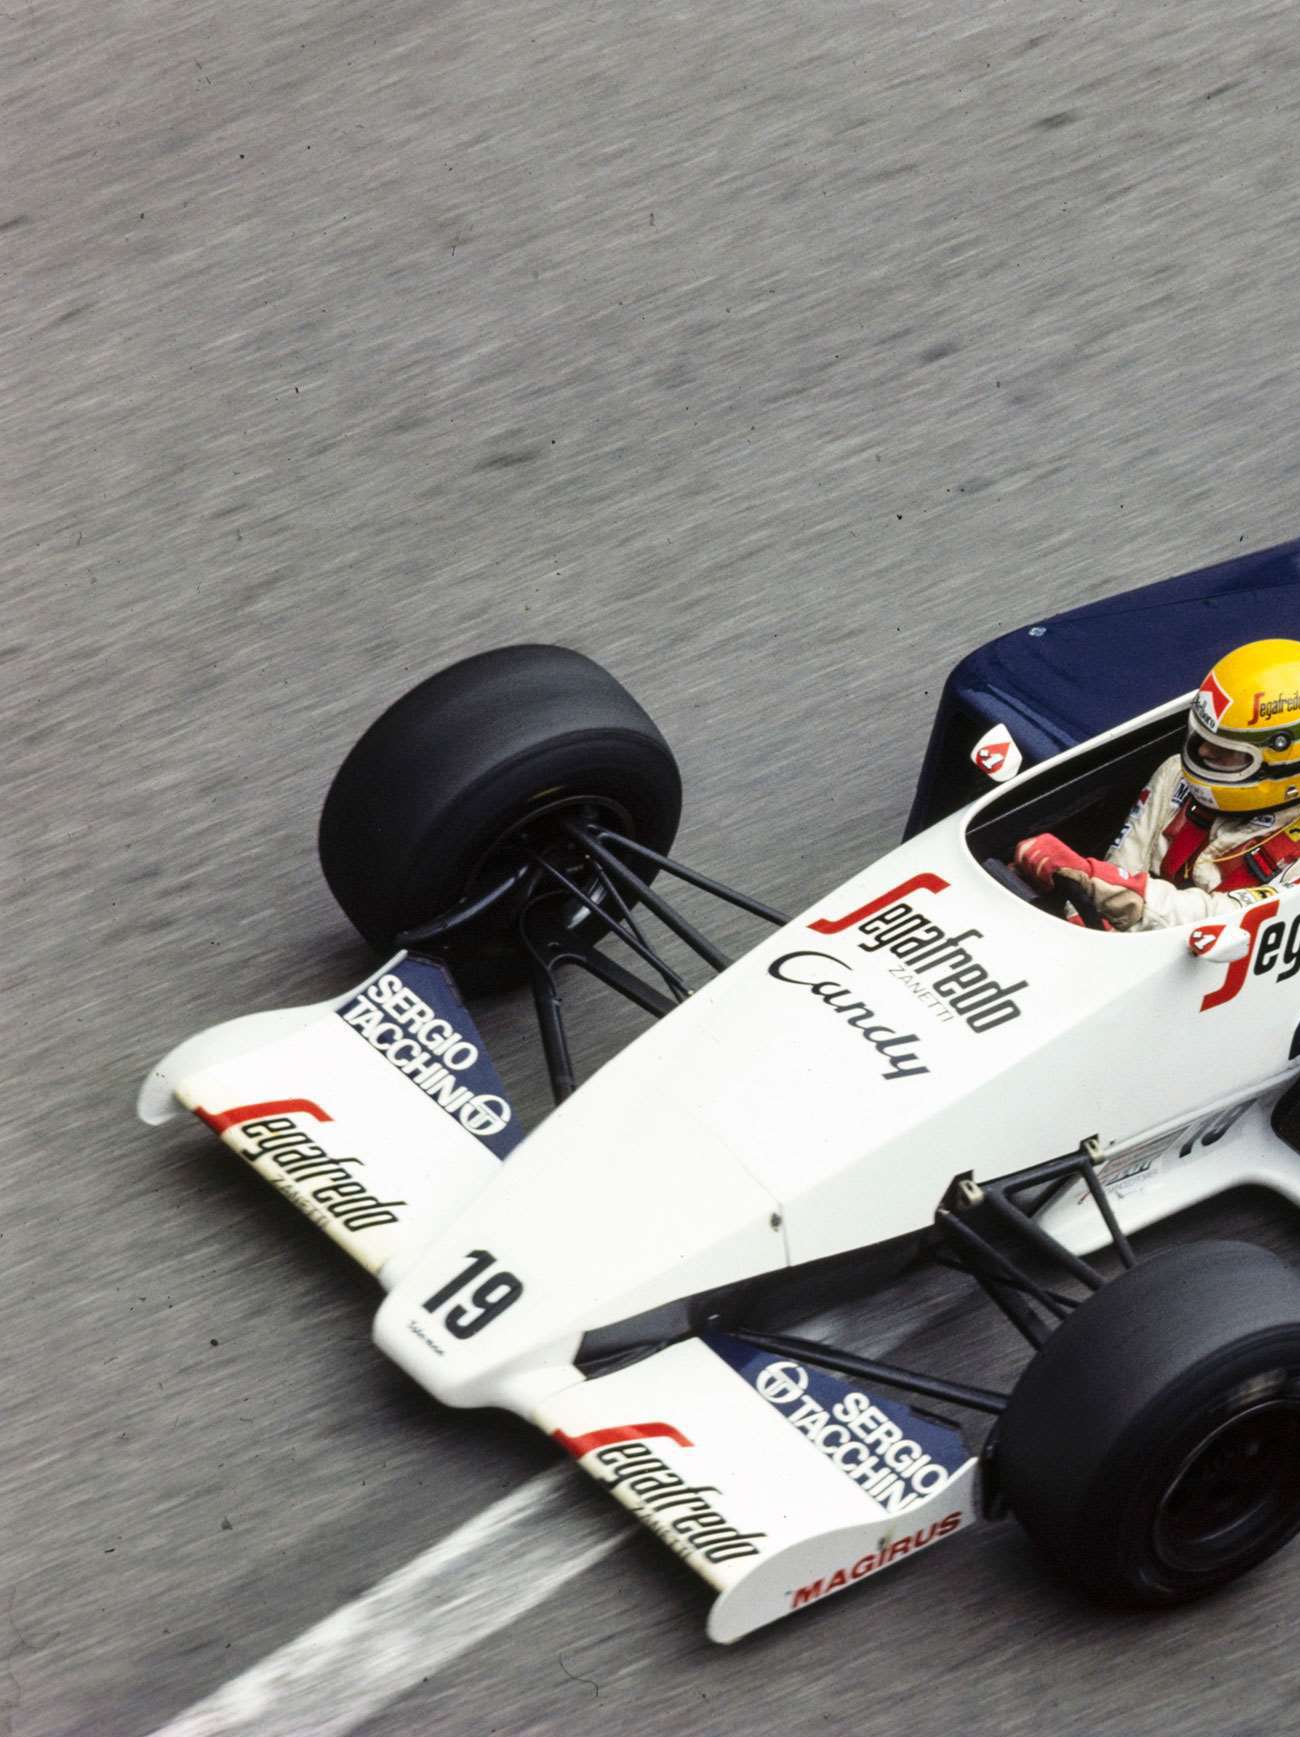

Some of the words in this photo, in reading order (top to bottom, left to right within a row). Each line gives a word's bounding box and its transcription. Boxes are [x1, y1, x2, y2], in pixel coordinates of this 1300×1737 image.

[806, 873, 1029, 1034] Segafredo
[888, 964, 955, 1024] ZANETTI
[342, 993, 474, 1113] TACCHINI
[367, 974, 479, 1071] SERGIO
[767, 950, 931, 1080] Candy
[194, 1098, 409, 1232] Segafredo
[421, 1248, 524, 1340] 19
[553, 1421, 768, 1564] Segafredo
[832, 1391, 950, 1495] SERGIO
[792, 1510, 965, 1609] MAGIRUS
